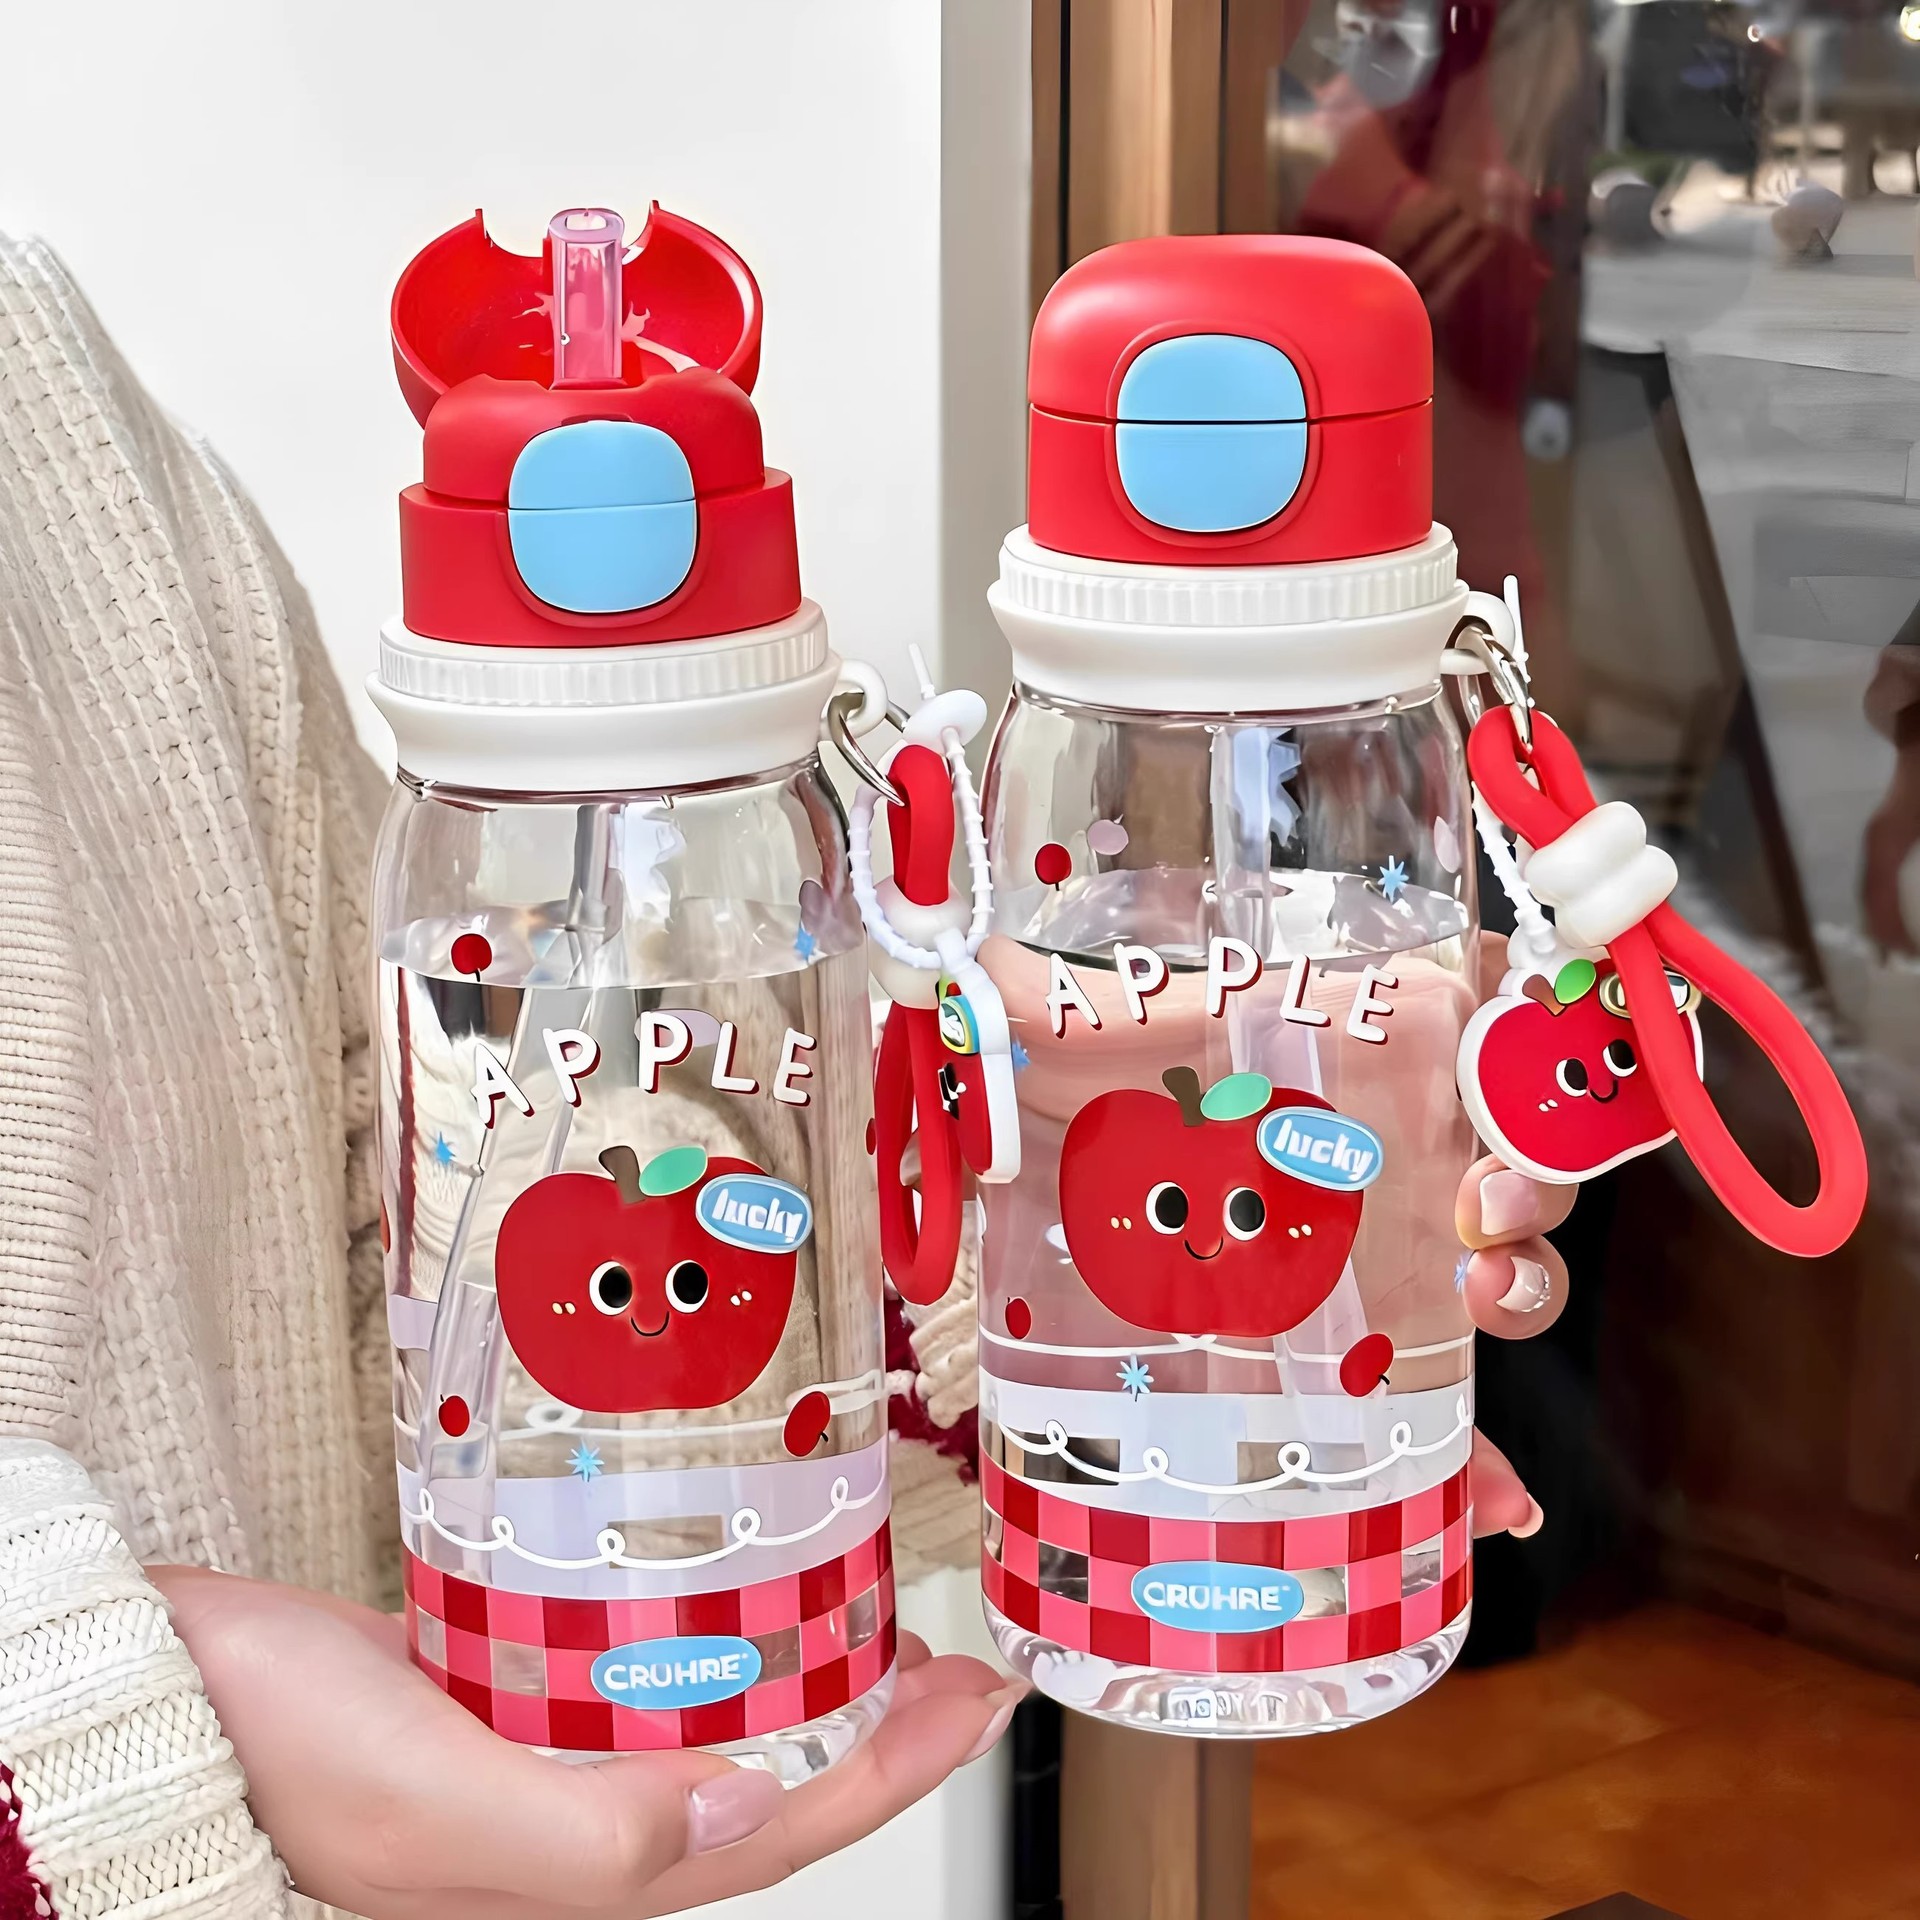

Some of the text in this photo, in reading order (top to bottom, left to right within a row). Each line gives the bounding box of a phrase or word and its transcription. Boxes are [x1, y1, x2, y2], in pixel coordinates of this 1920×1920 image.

[1046, 935, 1399, 1045] APPLE
[471, 1010, 818, 1129] APPLE
[1272, 1118, 1374, 1181] lucky
[711, 1187, 803, 1244] lucky
[1142, 1581, 1283, 1612] CRUHRE
[603, 1653, 742, 1691] CRUHRE
